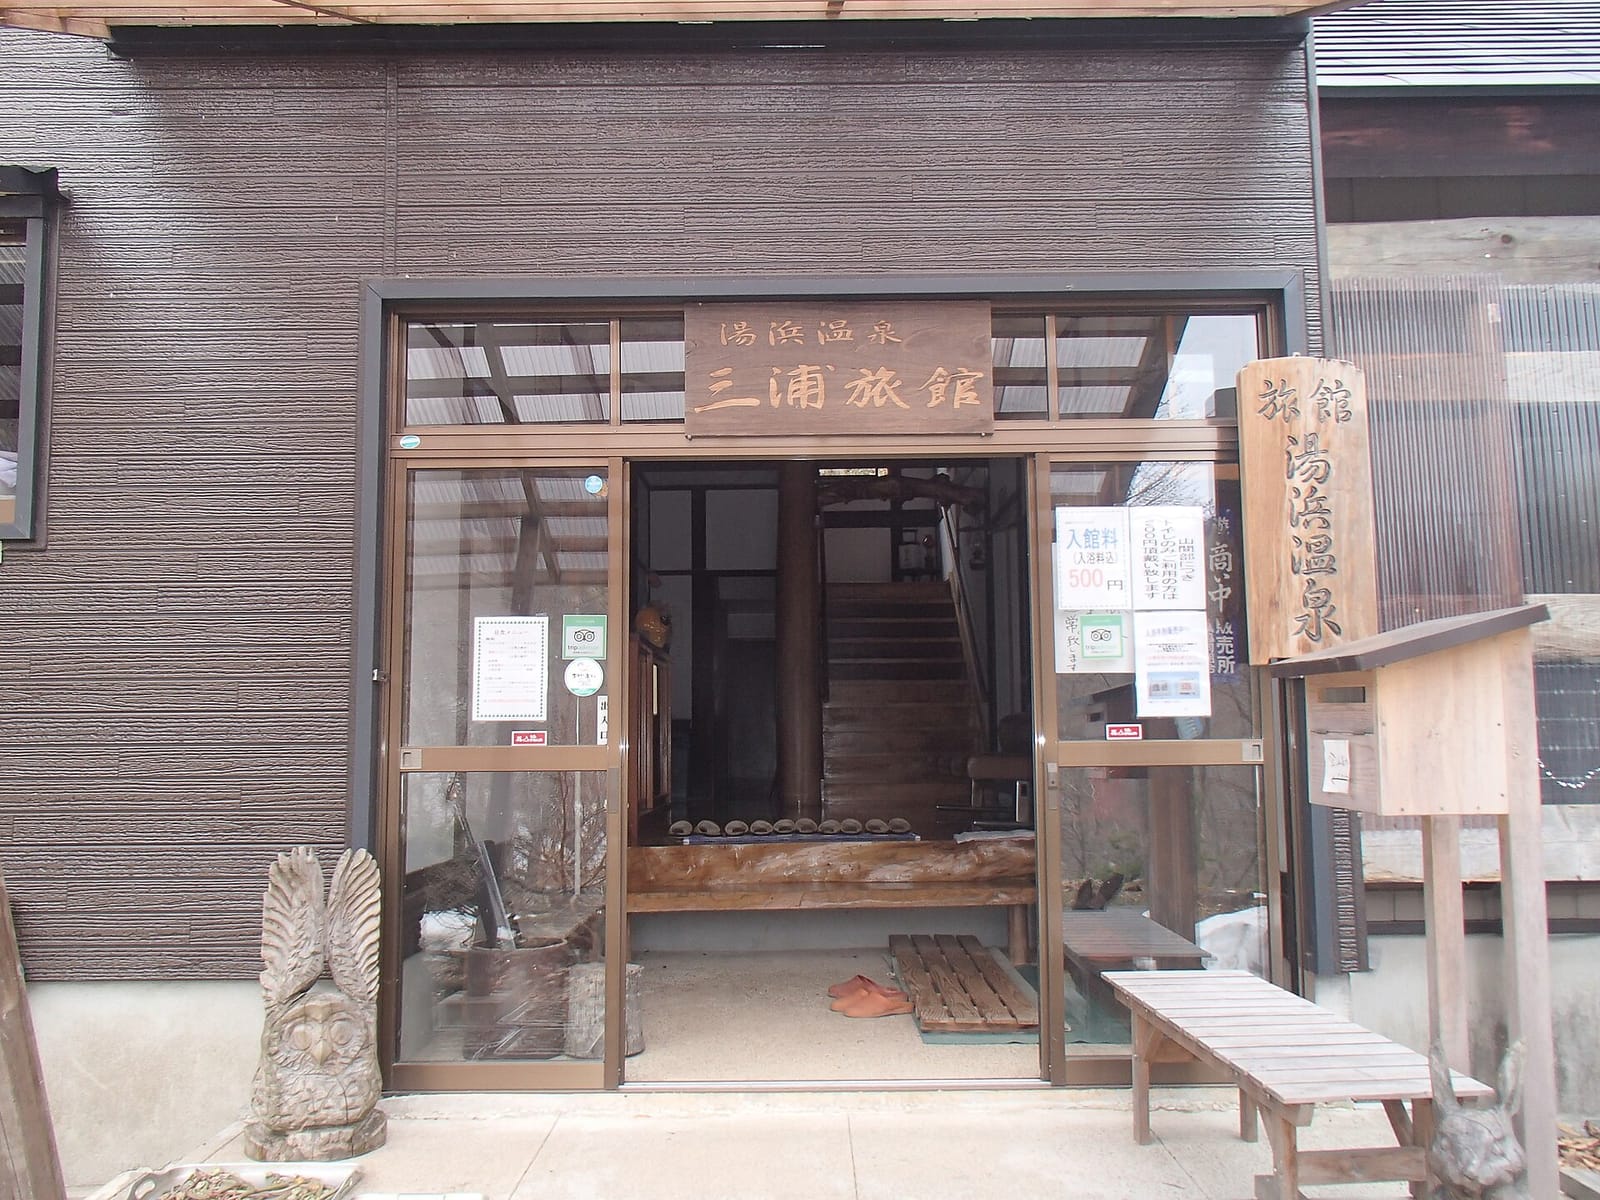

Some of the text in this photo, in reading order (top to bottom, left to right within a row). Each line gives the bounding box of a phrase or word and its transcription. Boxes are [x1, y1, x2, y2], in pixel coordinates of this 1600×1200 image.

[719, 319, 902, 346] 湯浜温泉
[693, 364, 985, 414] 三浦旅館
[1257, 378, 1353, 424] 旅館
[1066, 527, 1118, 550] 入館料
[1285, 431, 1343, 643] 湯浜温泉
[1207, 541, 1233, 613] 商い中
